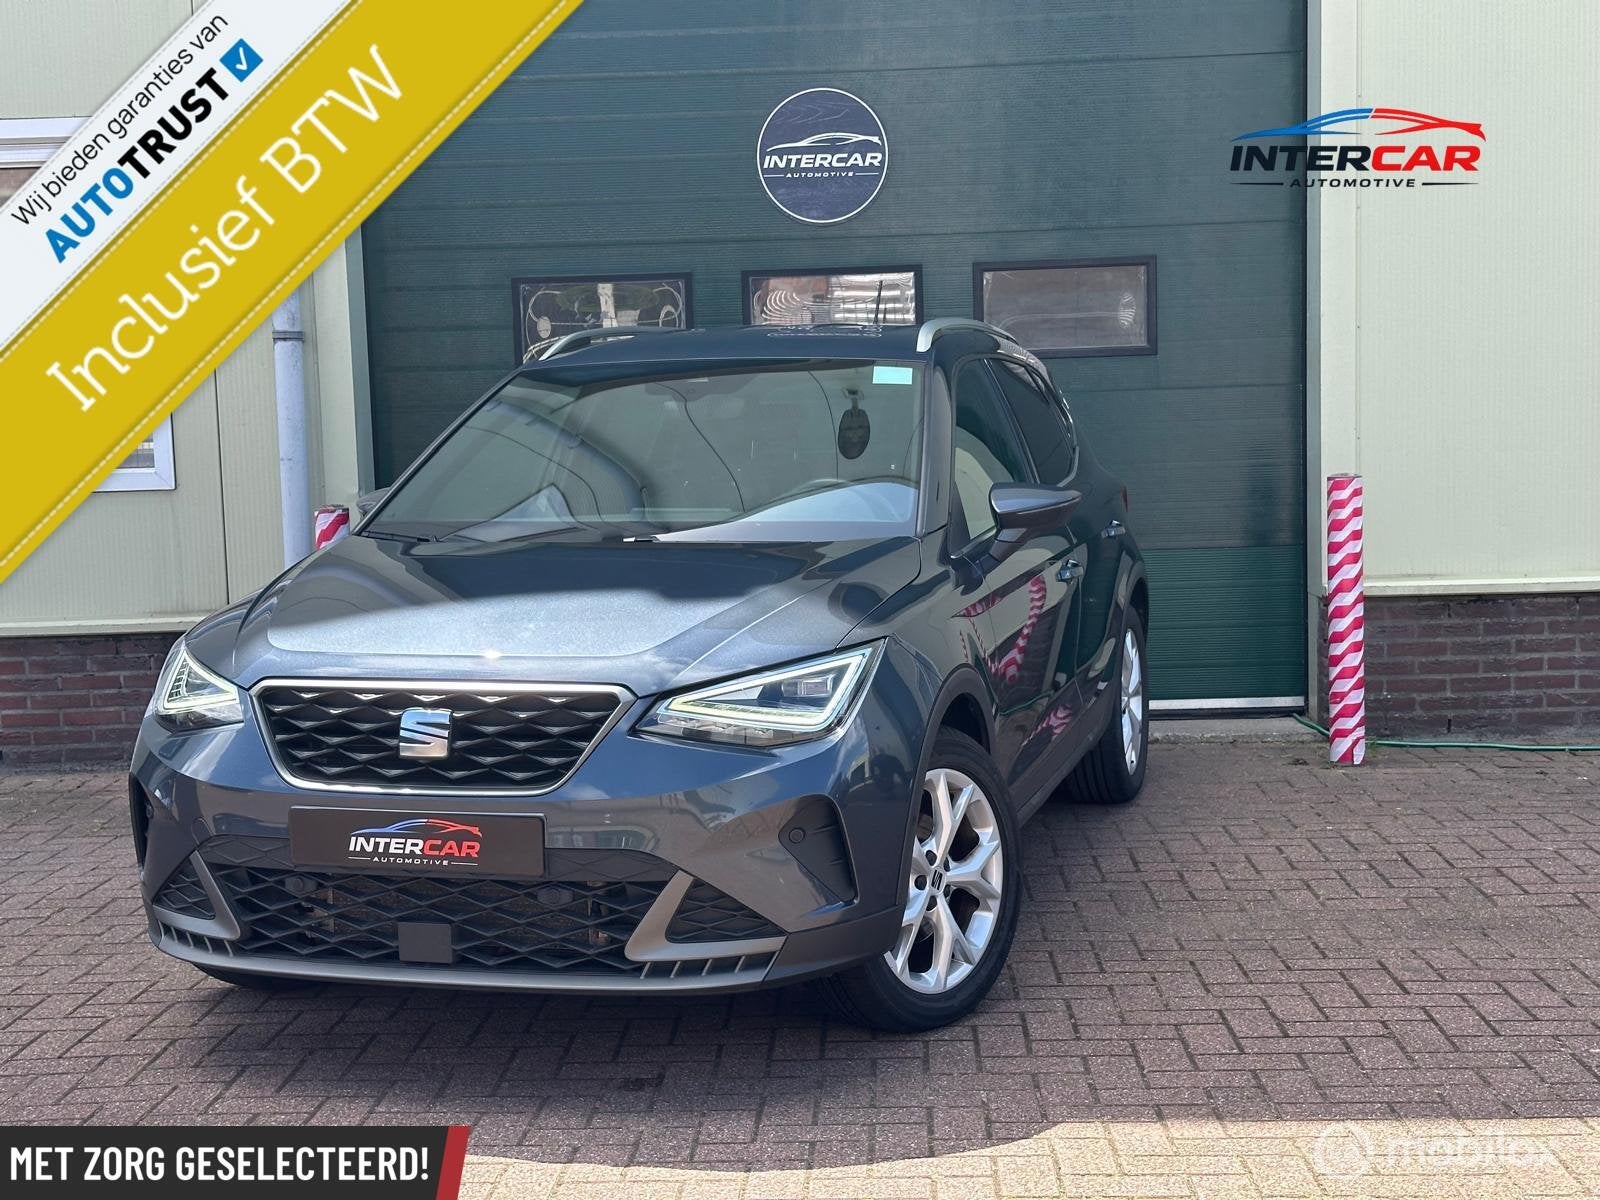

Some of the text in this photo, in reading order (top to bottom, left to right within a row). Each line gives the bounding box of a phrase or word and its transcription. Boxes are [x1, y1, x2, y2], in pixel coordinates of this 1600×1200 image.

[763, 152, 882, 168] INTERCAR
[349, 836, 481, 857] INTERCAR
[372, 857, 449, 866] AUTOMOTIVE
